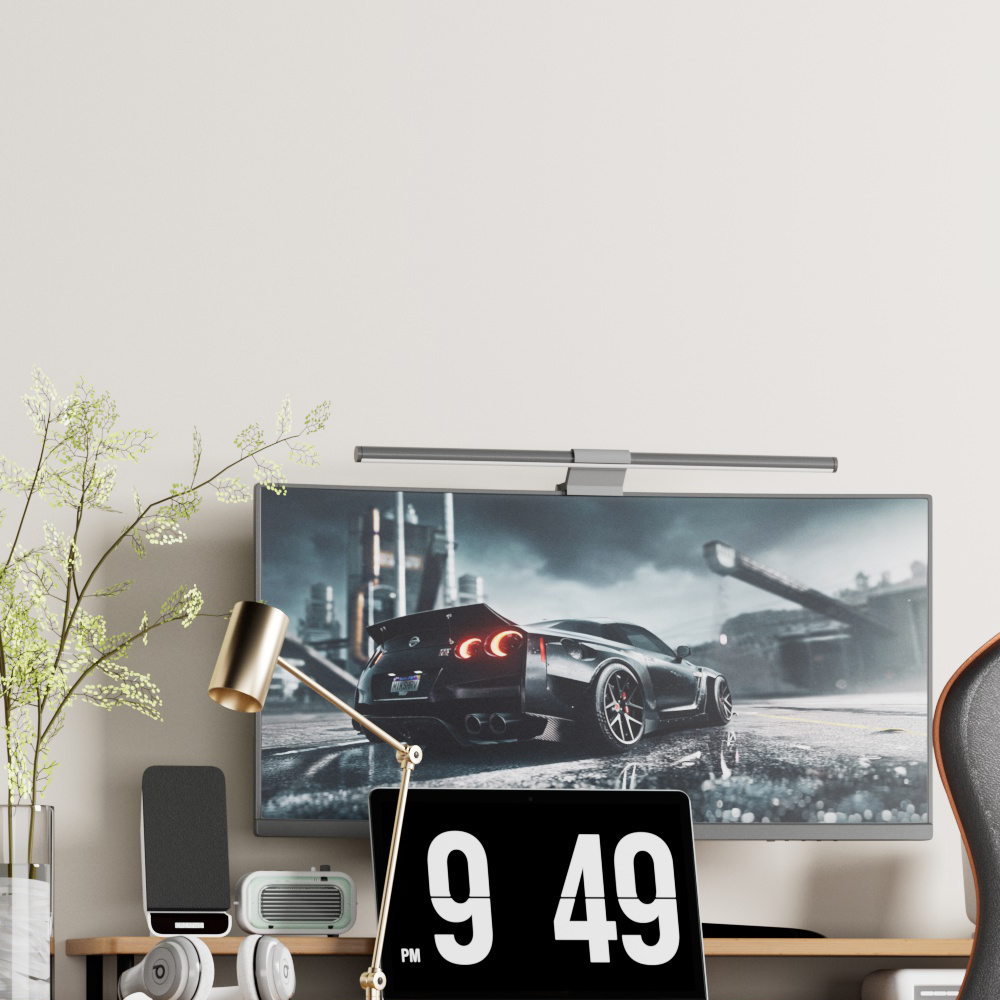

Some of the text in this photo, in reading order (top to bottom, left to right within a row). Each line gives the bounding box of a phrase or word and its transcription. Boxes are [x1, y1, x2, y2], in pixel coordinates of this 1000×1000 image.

[427, 830, 680, 966] 9 49
[400, 948, 421, 963] PM
